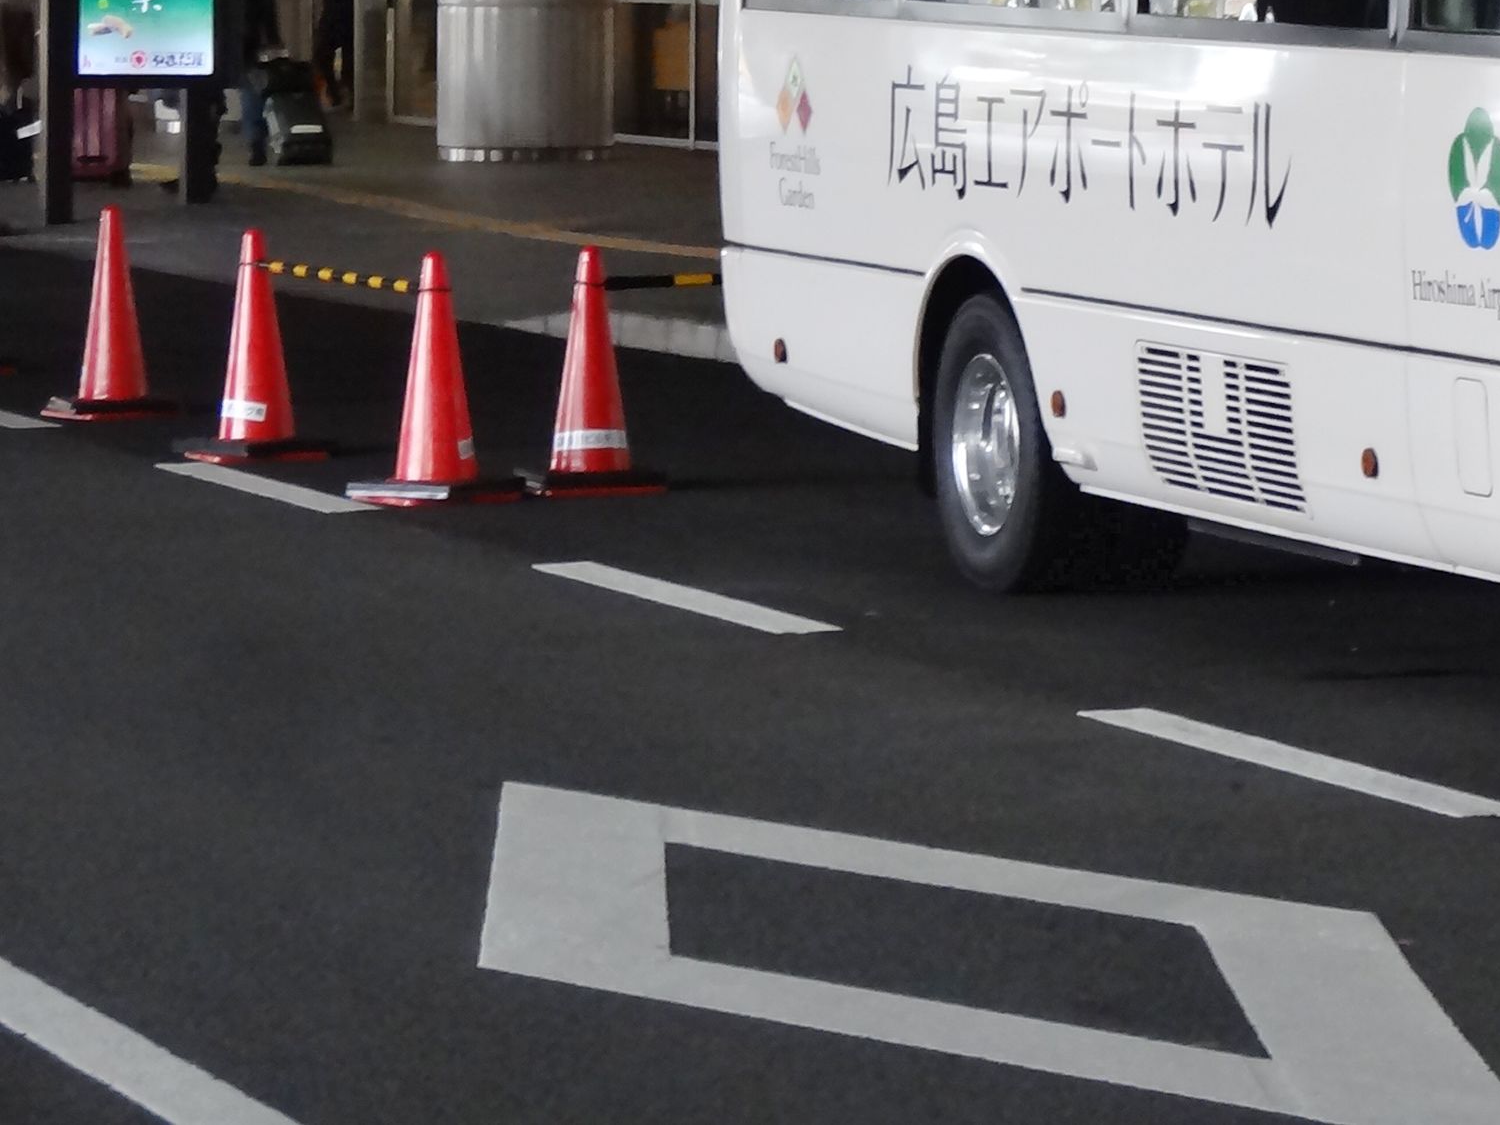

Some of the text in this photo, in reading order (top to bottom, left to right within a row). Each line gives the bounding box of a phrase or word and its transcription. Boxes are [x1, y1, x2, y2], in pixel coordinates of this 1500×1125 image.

[887, 65, 1292, 229] 広島エアポートホテル
[1411, 270, 1477, 307] Hiroshima
